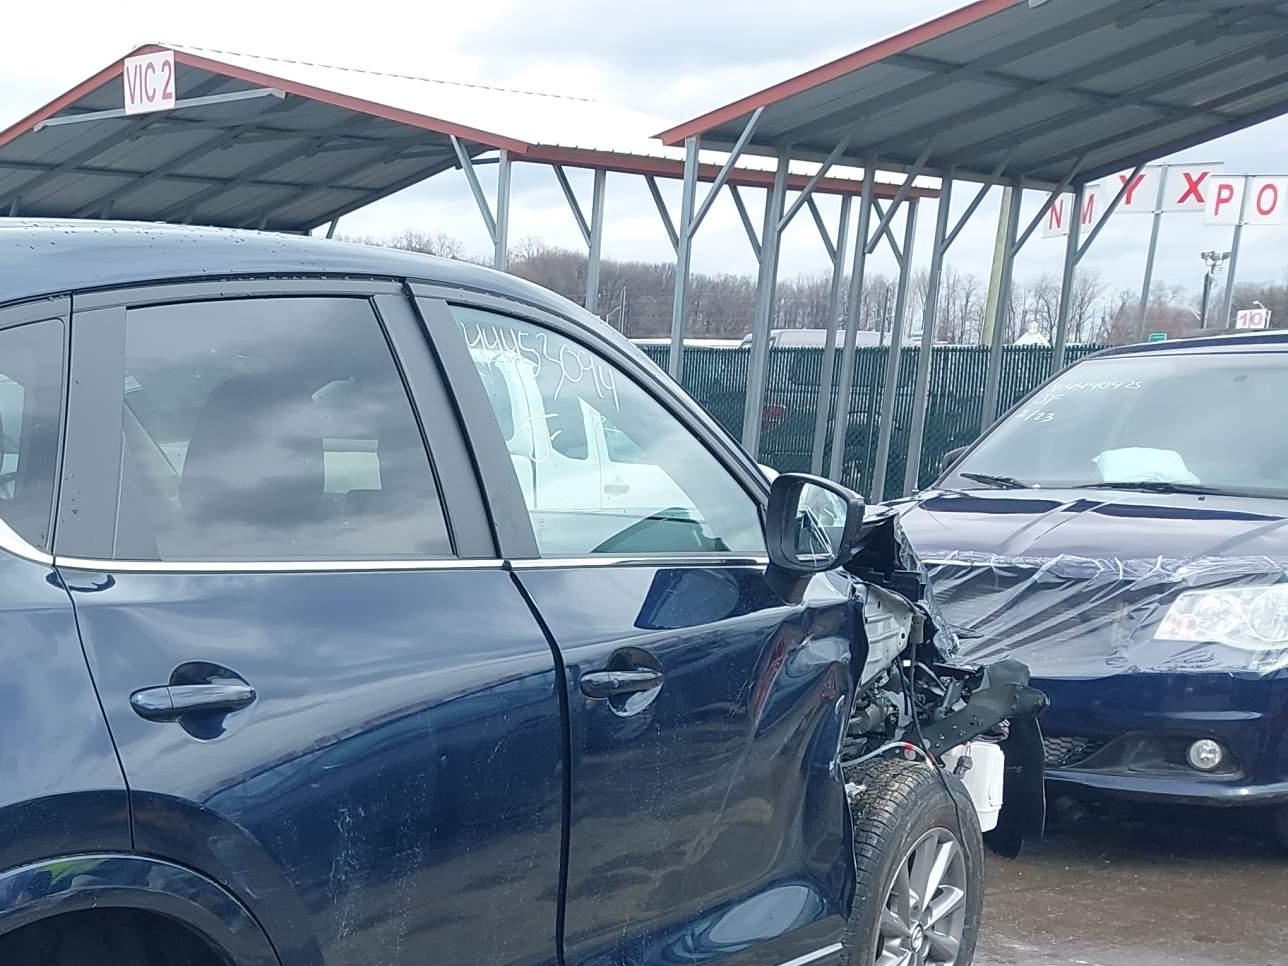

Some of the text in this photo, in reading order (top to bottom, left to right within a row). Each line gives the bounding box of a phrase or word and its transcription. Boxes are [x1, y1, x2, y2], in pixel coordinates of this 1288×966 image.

[126, 59, 173, 105] VIC 2
[1119, 171, 1210, 205] Y X
[1214, 183, 1278, 216] P O
[1048, 198, 1064, 229] N
